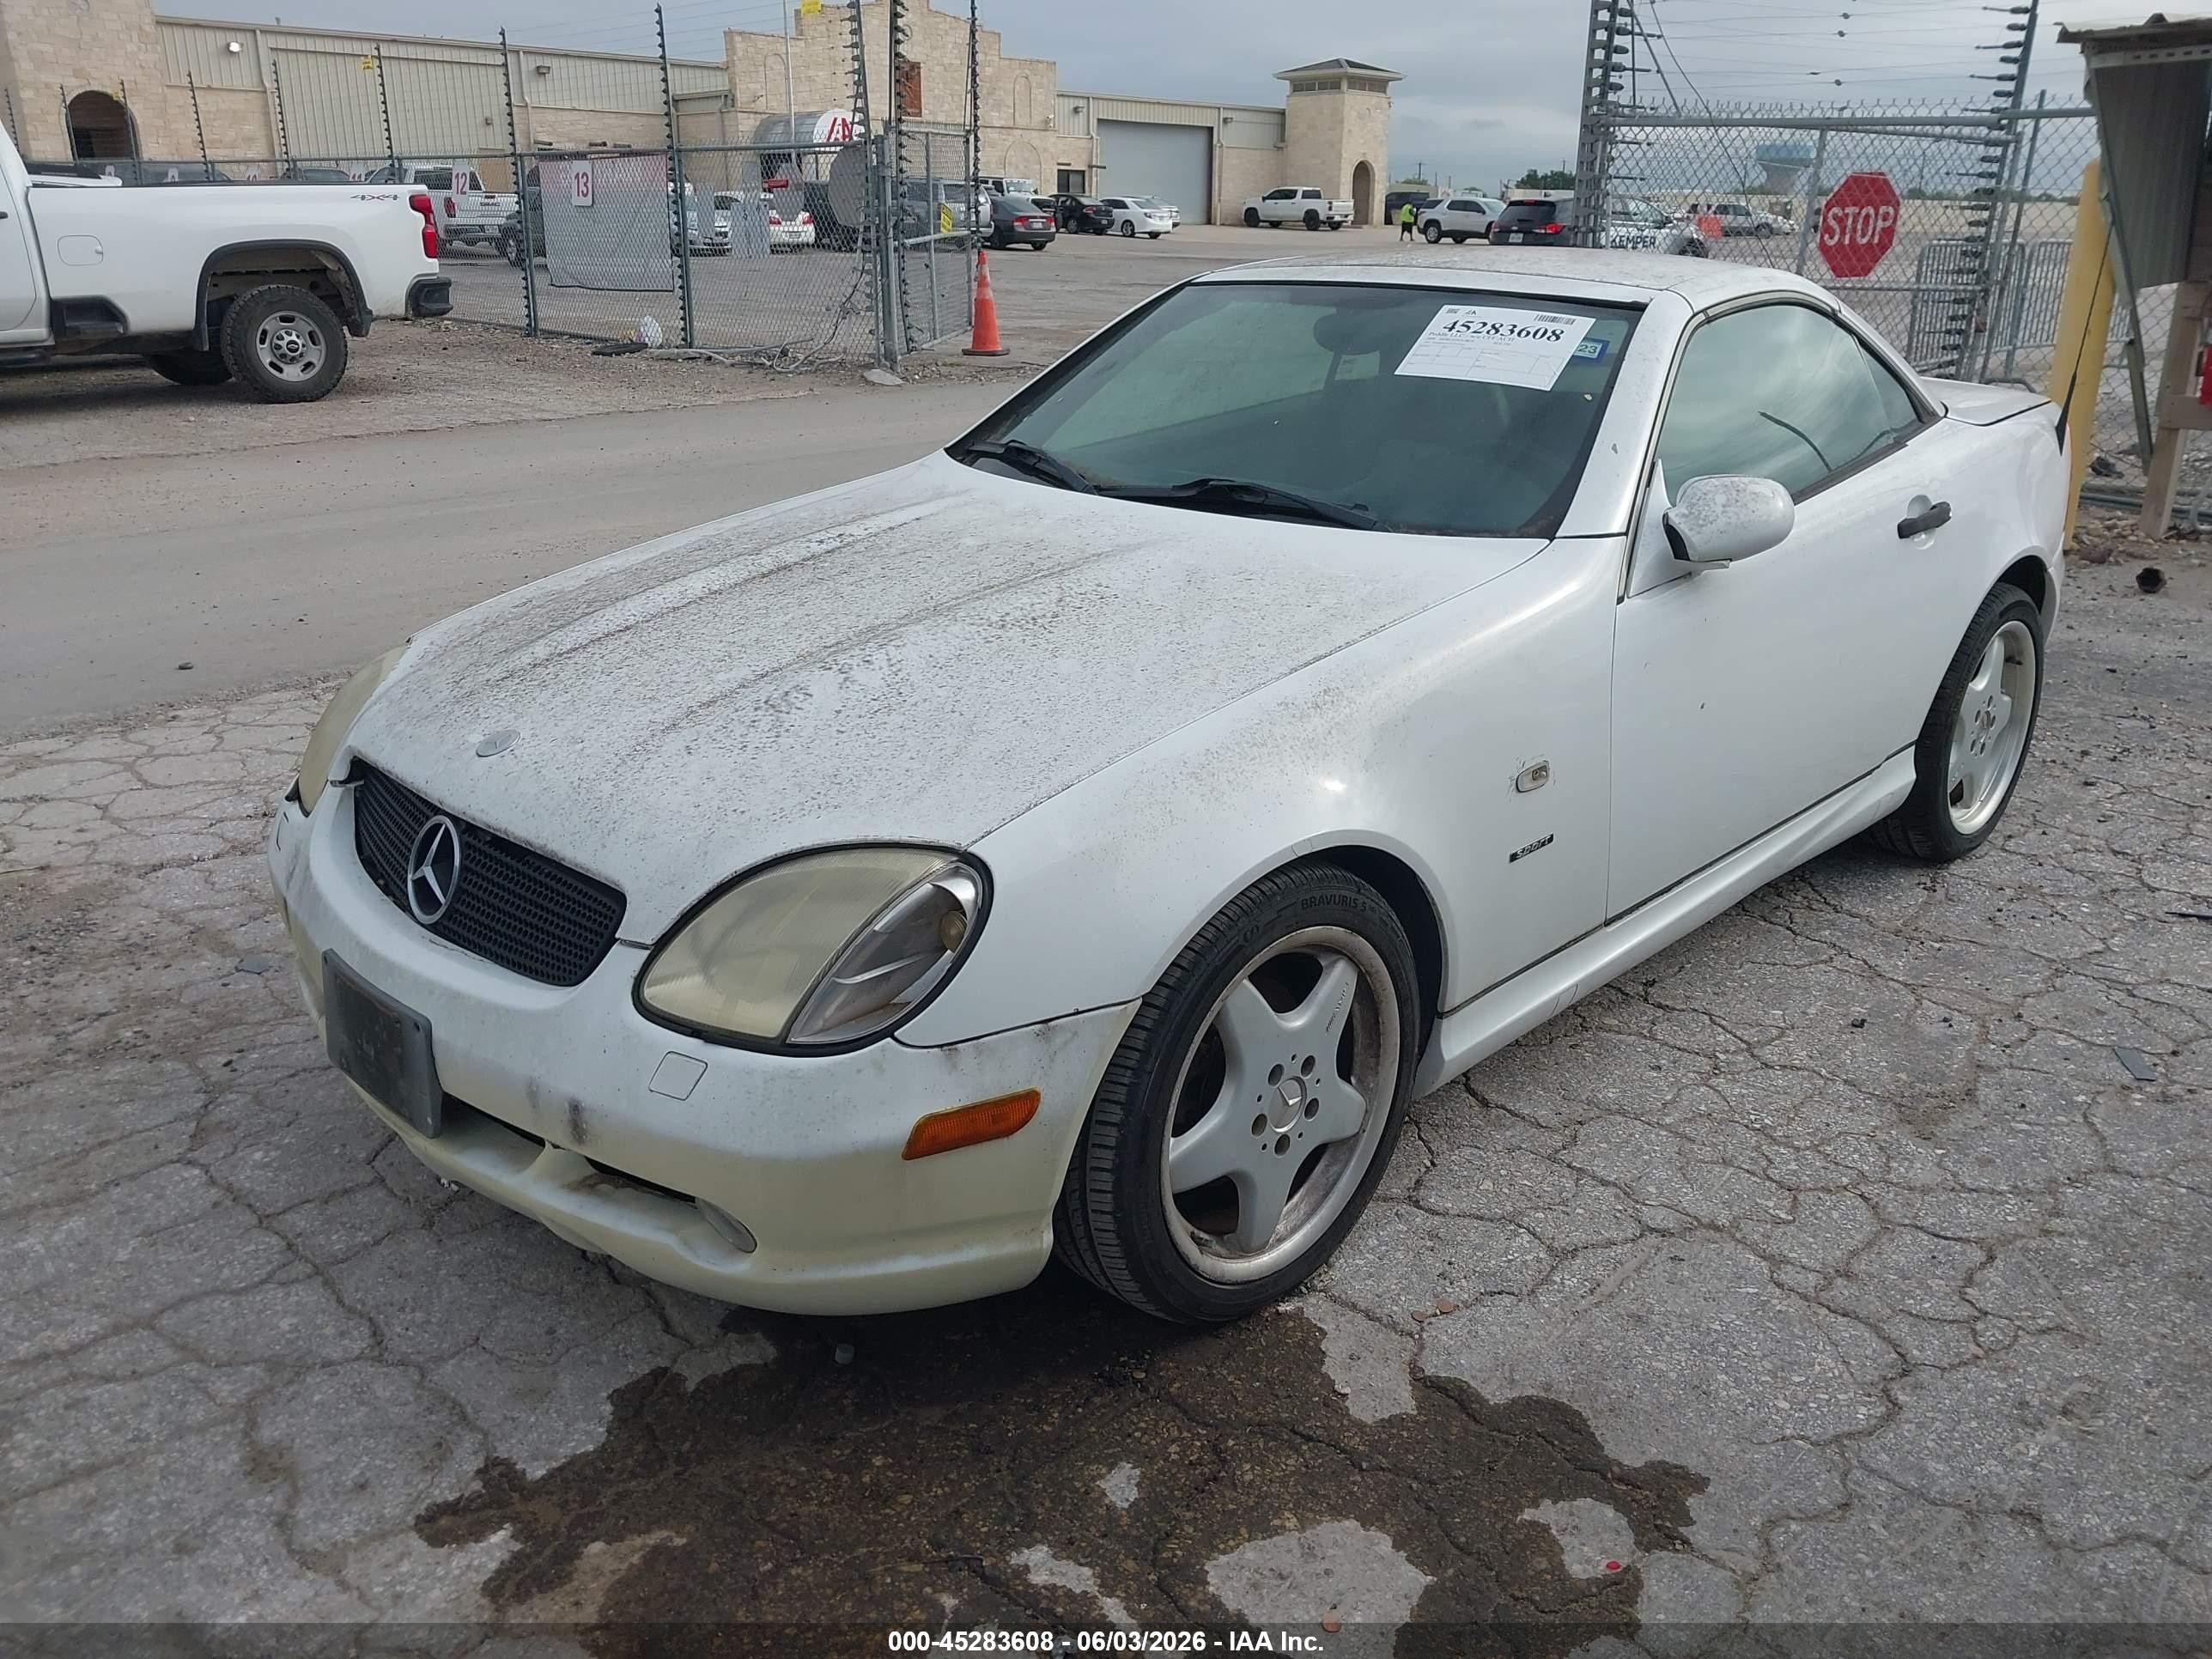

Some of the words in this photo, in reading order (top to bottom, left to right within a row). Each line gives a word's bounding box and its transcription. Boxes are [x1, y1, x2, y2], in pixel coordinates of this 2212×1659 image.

[454, 172, 467, 195] 12
[574, 172, 589, 198] 13
[1824, 205, 1894, 246] STOP
[1610, 234, 1656, 248] KEMPER
[1443, 319, 1565, 343] 45283608
[1577, 344, 1598, 354] 23
[1301, 894, 1359, 910] BRAVURIS
[1360, 901, 1367, 912] 5
